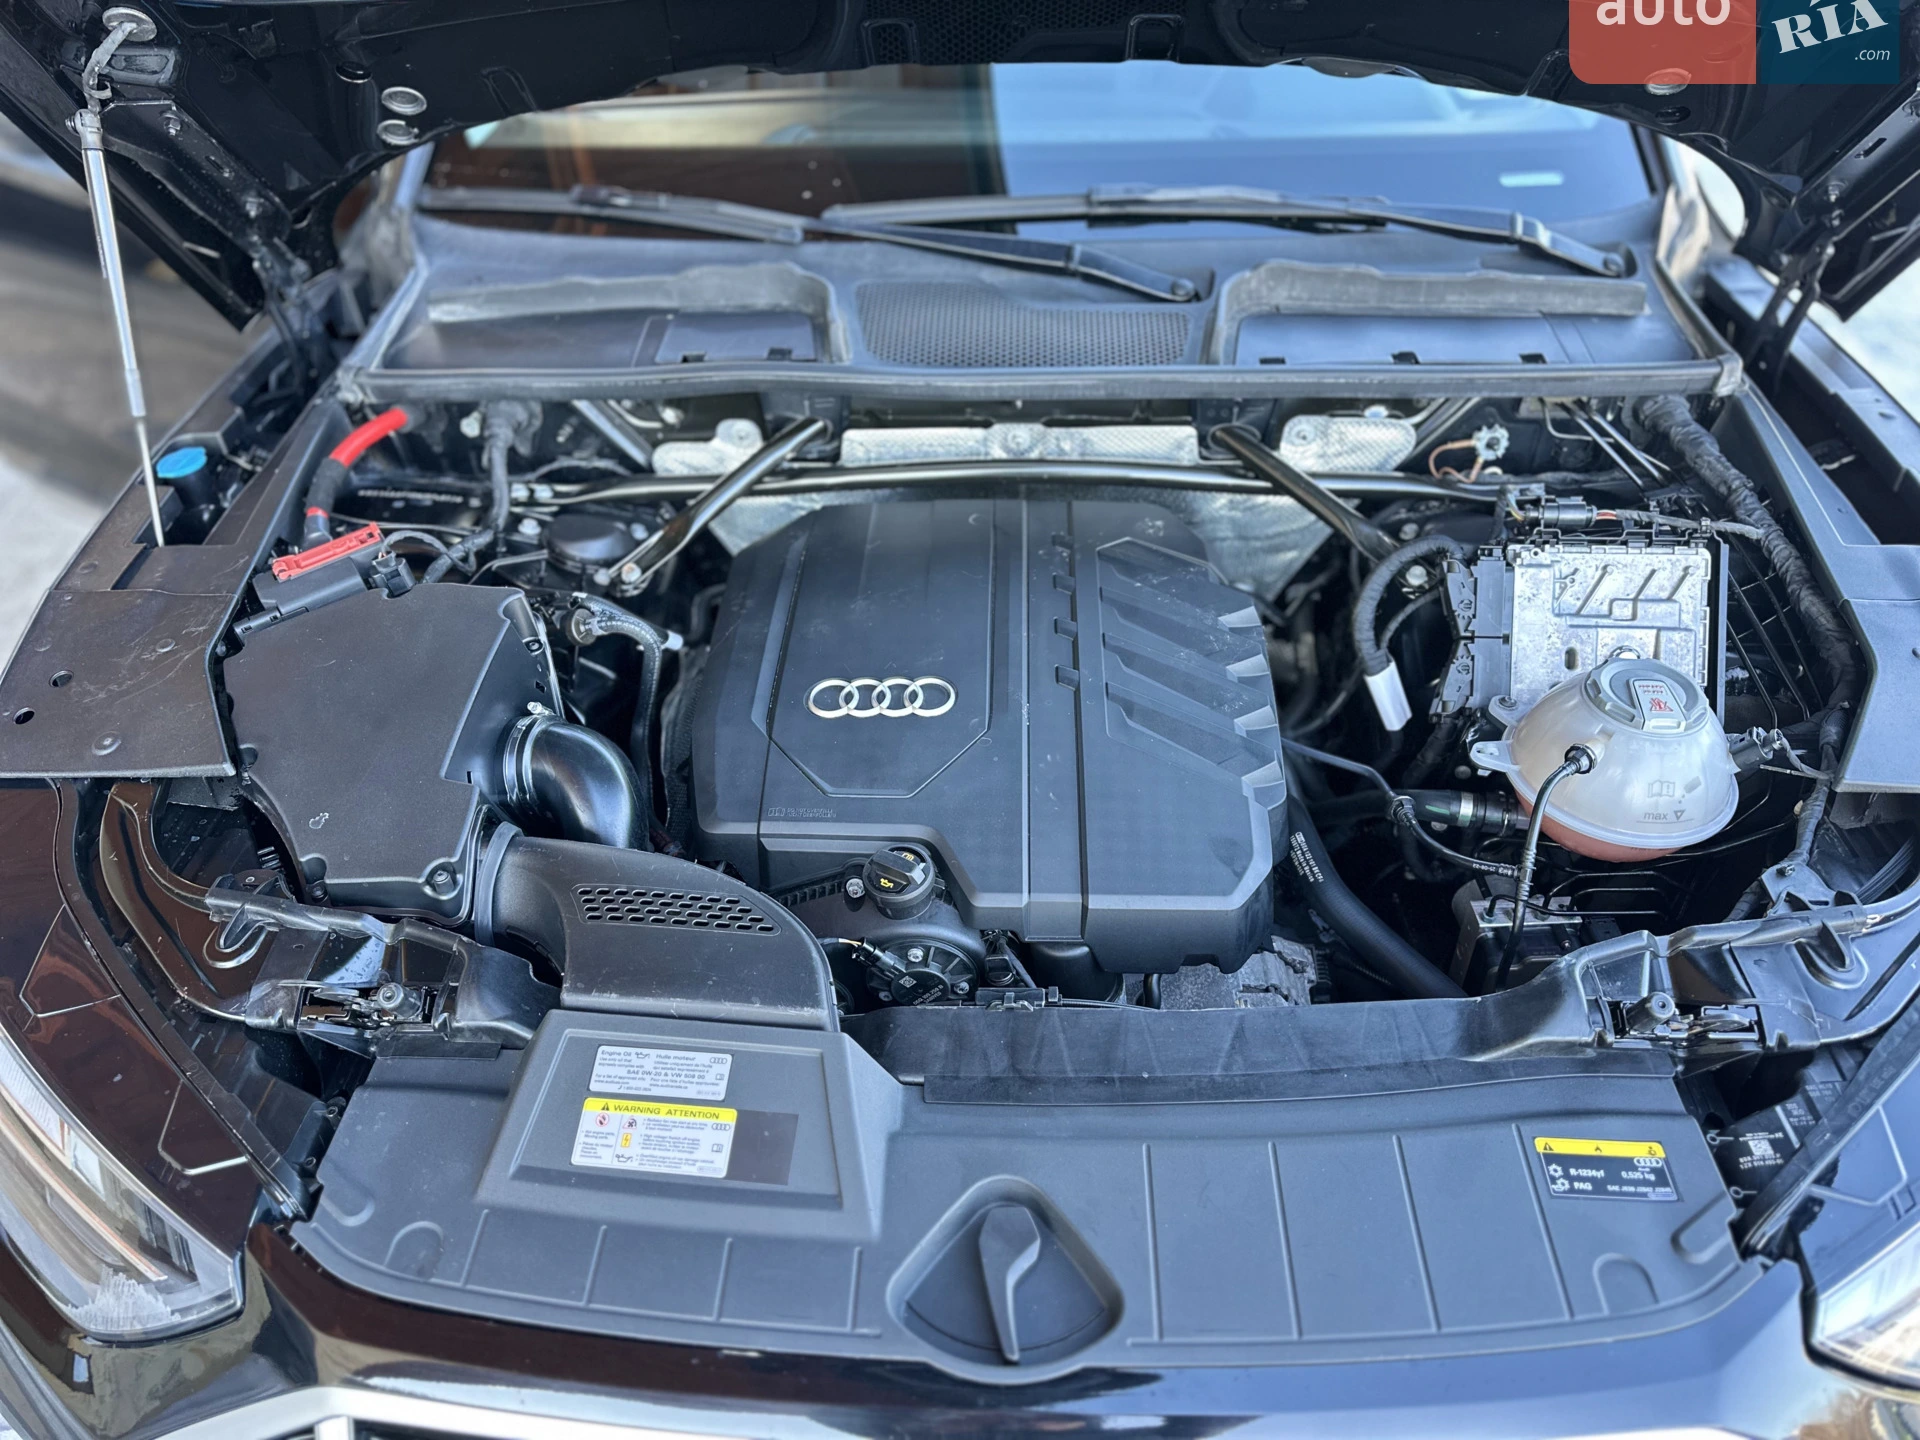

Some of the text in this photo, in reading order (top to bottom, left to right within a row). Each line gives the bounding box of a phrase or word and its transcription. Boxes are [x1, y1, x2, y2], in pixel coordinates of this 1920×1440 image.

[1644, 812, 1668, 821] max
[614, 1104, 720, 1120] WARNING ATTENTION
[1569, 1168, 1604, 1178] R-1234yf
[1644, 1172, 1655, 1181] kg
[1574, 1182, 1592, 1190] PAG
